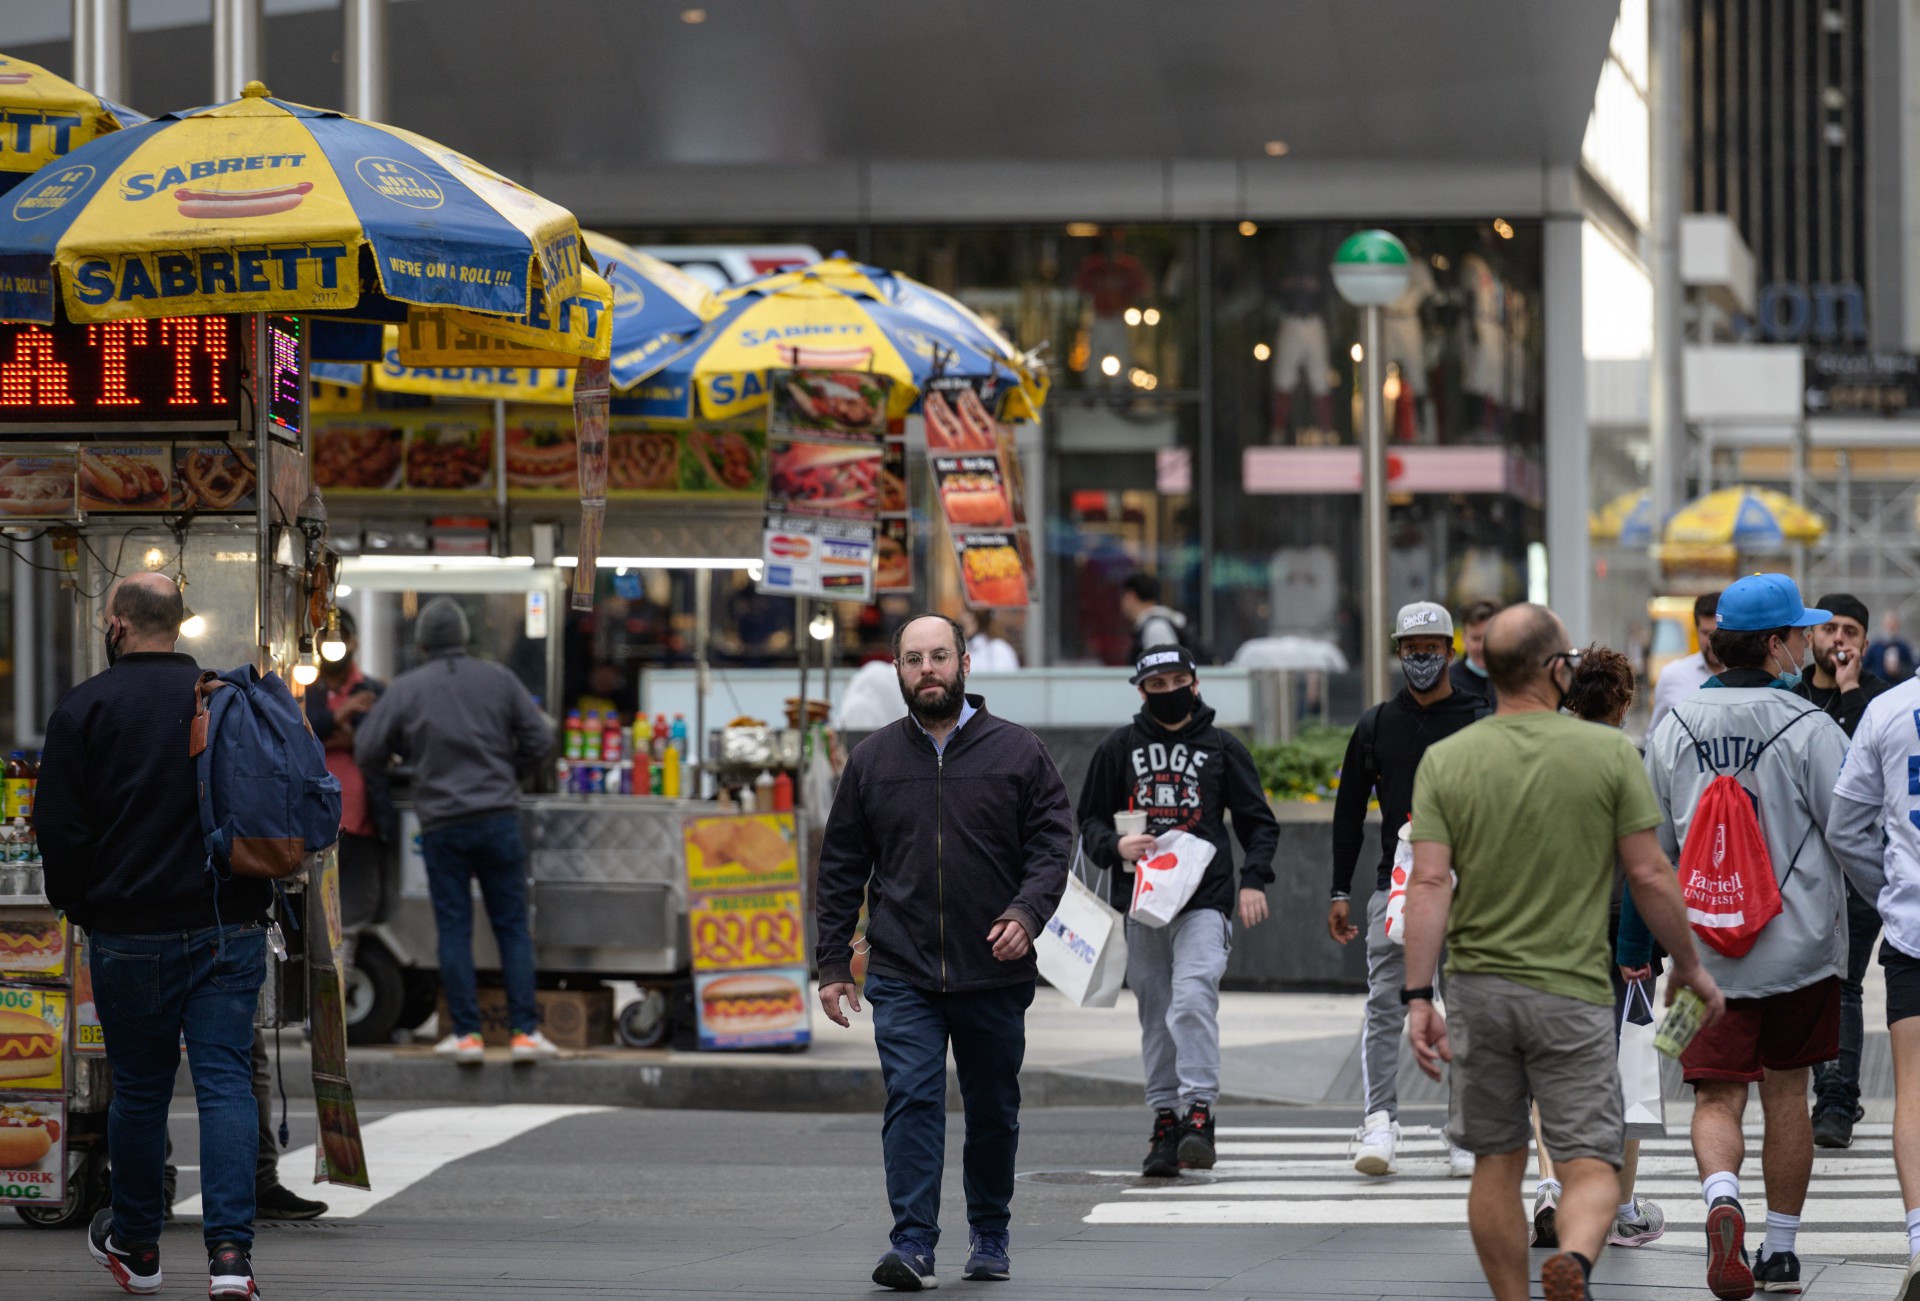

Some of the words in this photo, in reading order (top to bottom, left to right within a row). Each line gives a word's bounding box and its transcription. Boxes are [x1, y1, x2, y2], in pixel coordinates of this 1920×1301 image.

[119, 153, 307, 202] SABRETT
[377, 185, 441, 199] INSPECTED
[72, 240, 347, 306] SABRETT
[388, 256, 423, 279] WE'RE
[425, 262, 446, 278] ON
[449, 264, 457, 280] A
[459, 265, 492, 285] ROLL
[15, 276, 39, 294] ROLL
[311, 292, 339, 303] 2017
[1131, 743, 1209, 778] EDGE
[1697, 736, 1765, 774] RUTH
[1155, 773, 1181, 783] RATD
[1686, 869, 1744, 893] Fairiel
[1683, 887, 1745, 906] UNIVERSIY
[79, 1025, 105, 1044] BE
[6, 1171, 54, 1184] YORK
